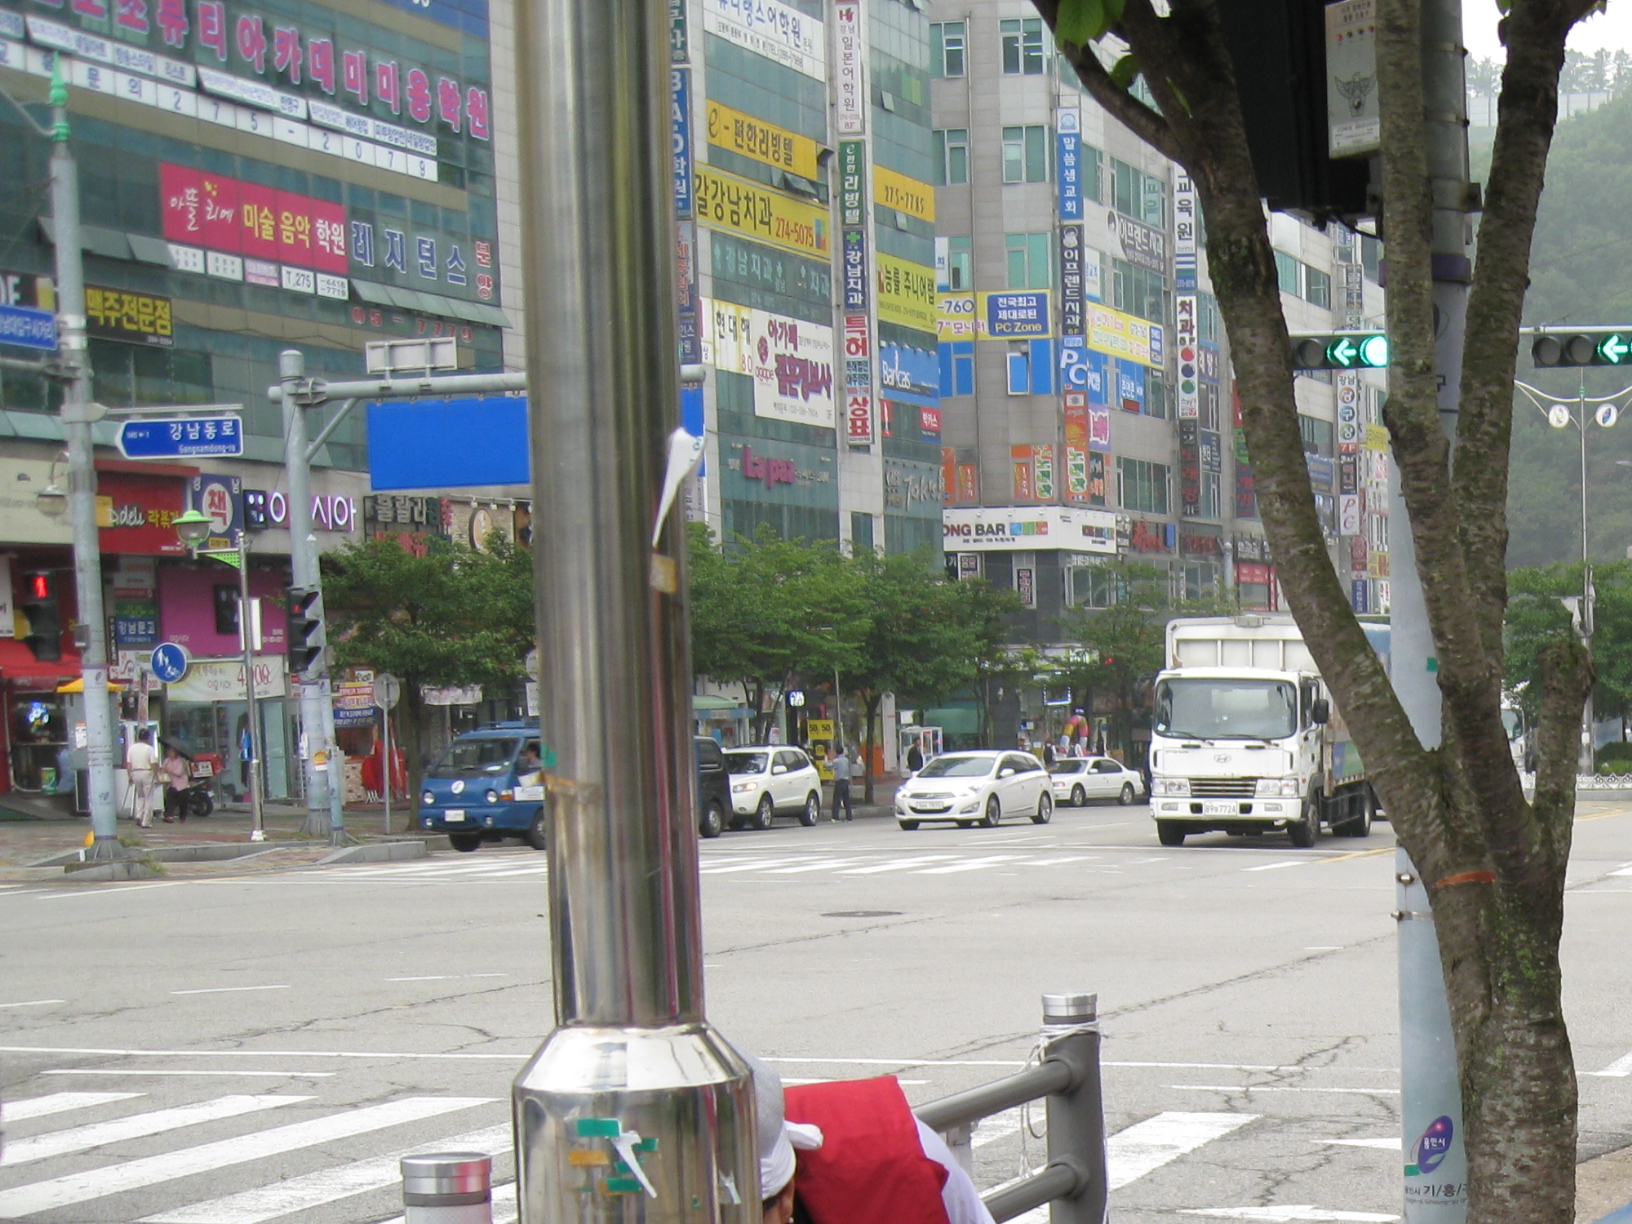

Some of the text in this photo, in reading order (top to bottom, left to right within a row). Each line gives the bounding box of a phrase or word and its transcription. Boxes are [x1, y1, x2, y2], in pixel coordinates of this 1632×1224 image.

[841, 36, 856, 112] 일본어학원
[1063, 136, 1077, 215] 말씀샘교회
[243, 204, 346, 256] 미술 음악 학원
[776, 216, 814, 248] 274-5075
[351, 221, 467, 287] 레지던스
[475, 241, 494, 300] 분양
[845, 250, 862, 306] 강남치과
[85, 287, 172, 336] 맥주전문점
[997, 296, 1037, 308] 전국최고
[1179, 299, 1195, 338] 치과
[845, 315, 869, 358] 특허
[995, 322, 1042, 333] PC Zone
[169, 420, 236, 441] 강남동로
[847, 397, 871, 437] 상표
[974, 523, 1006, 537] BAR
[1423, 1137, 1446, 1150] 용인시
